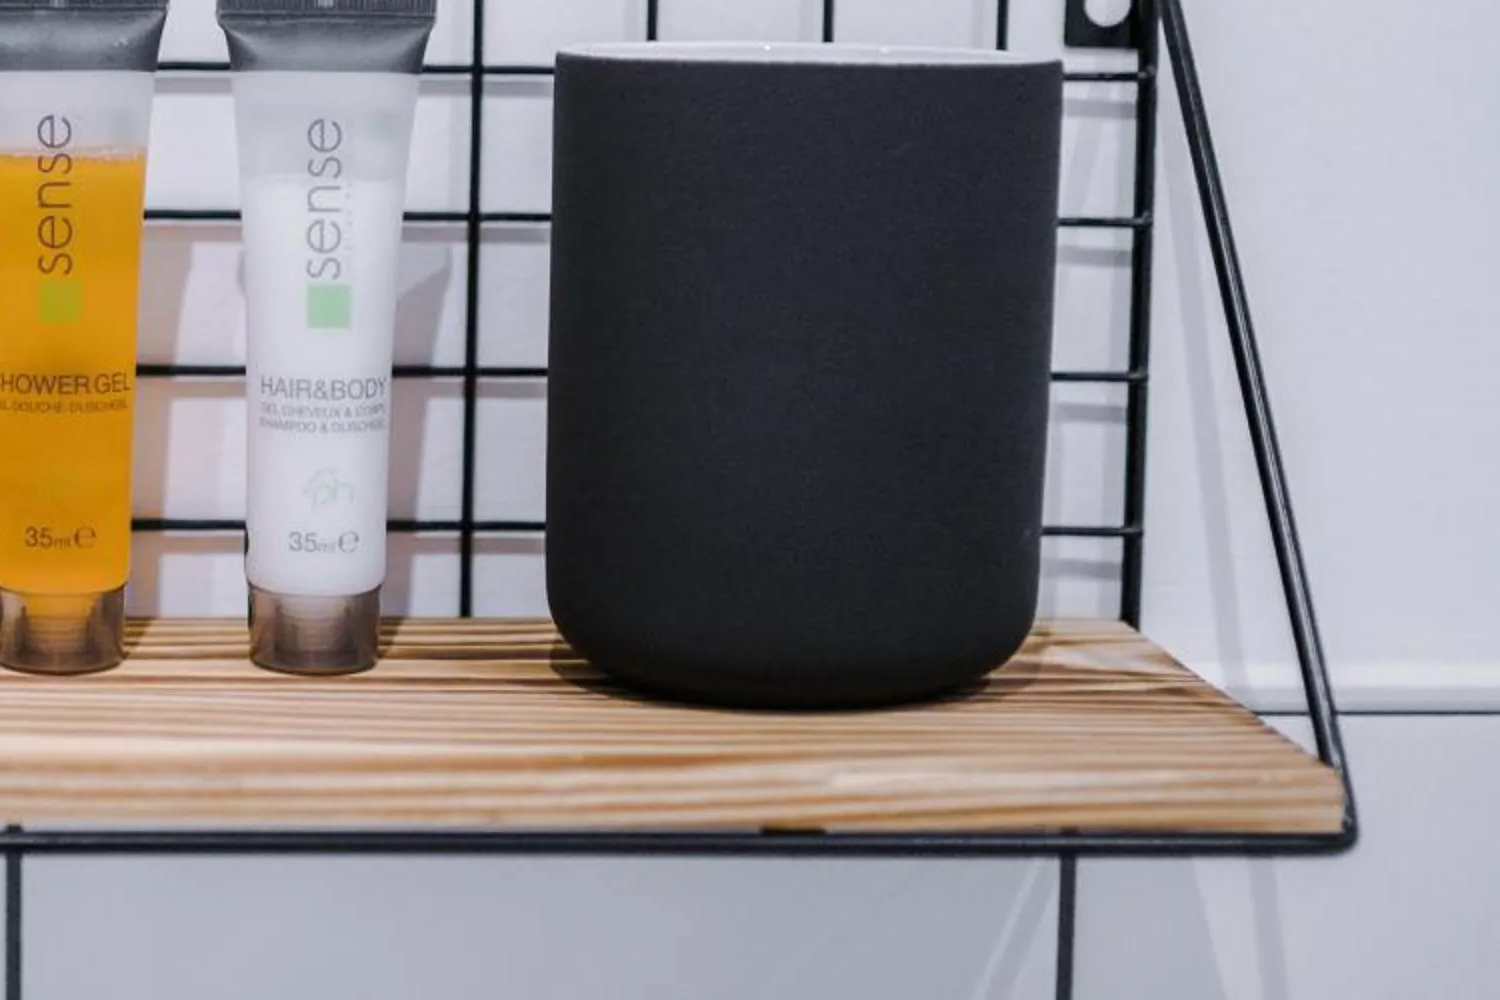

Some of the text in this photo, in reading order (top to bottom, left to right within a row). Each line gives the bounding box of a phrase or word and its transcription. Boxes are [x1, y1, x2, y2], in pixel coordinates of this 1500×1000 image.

[37, 114, 74, 276] sense
[306, 117, 343, 281] sense
[94, 371, 131, 395] GEL
[260, 375, 388, 401] HAIR&BODY
